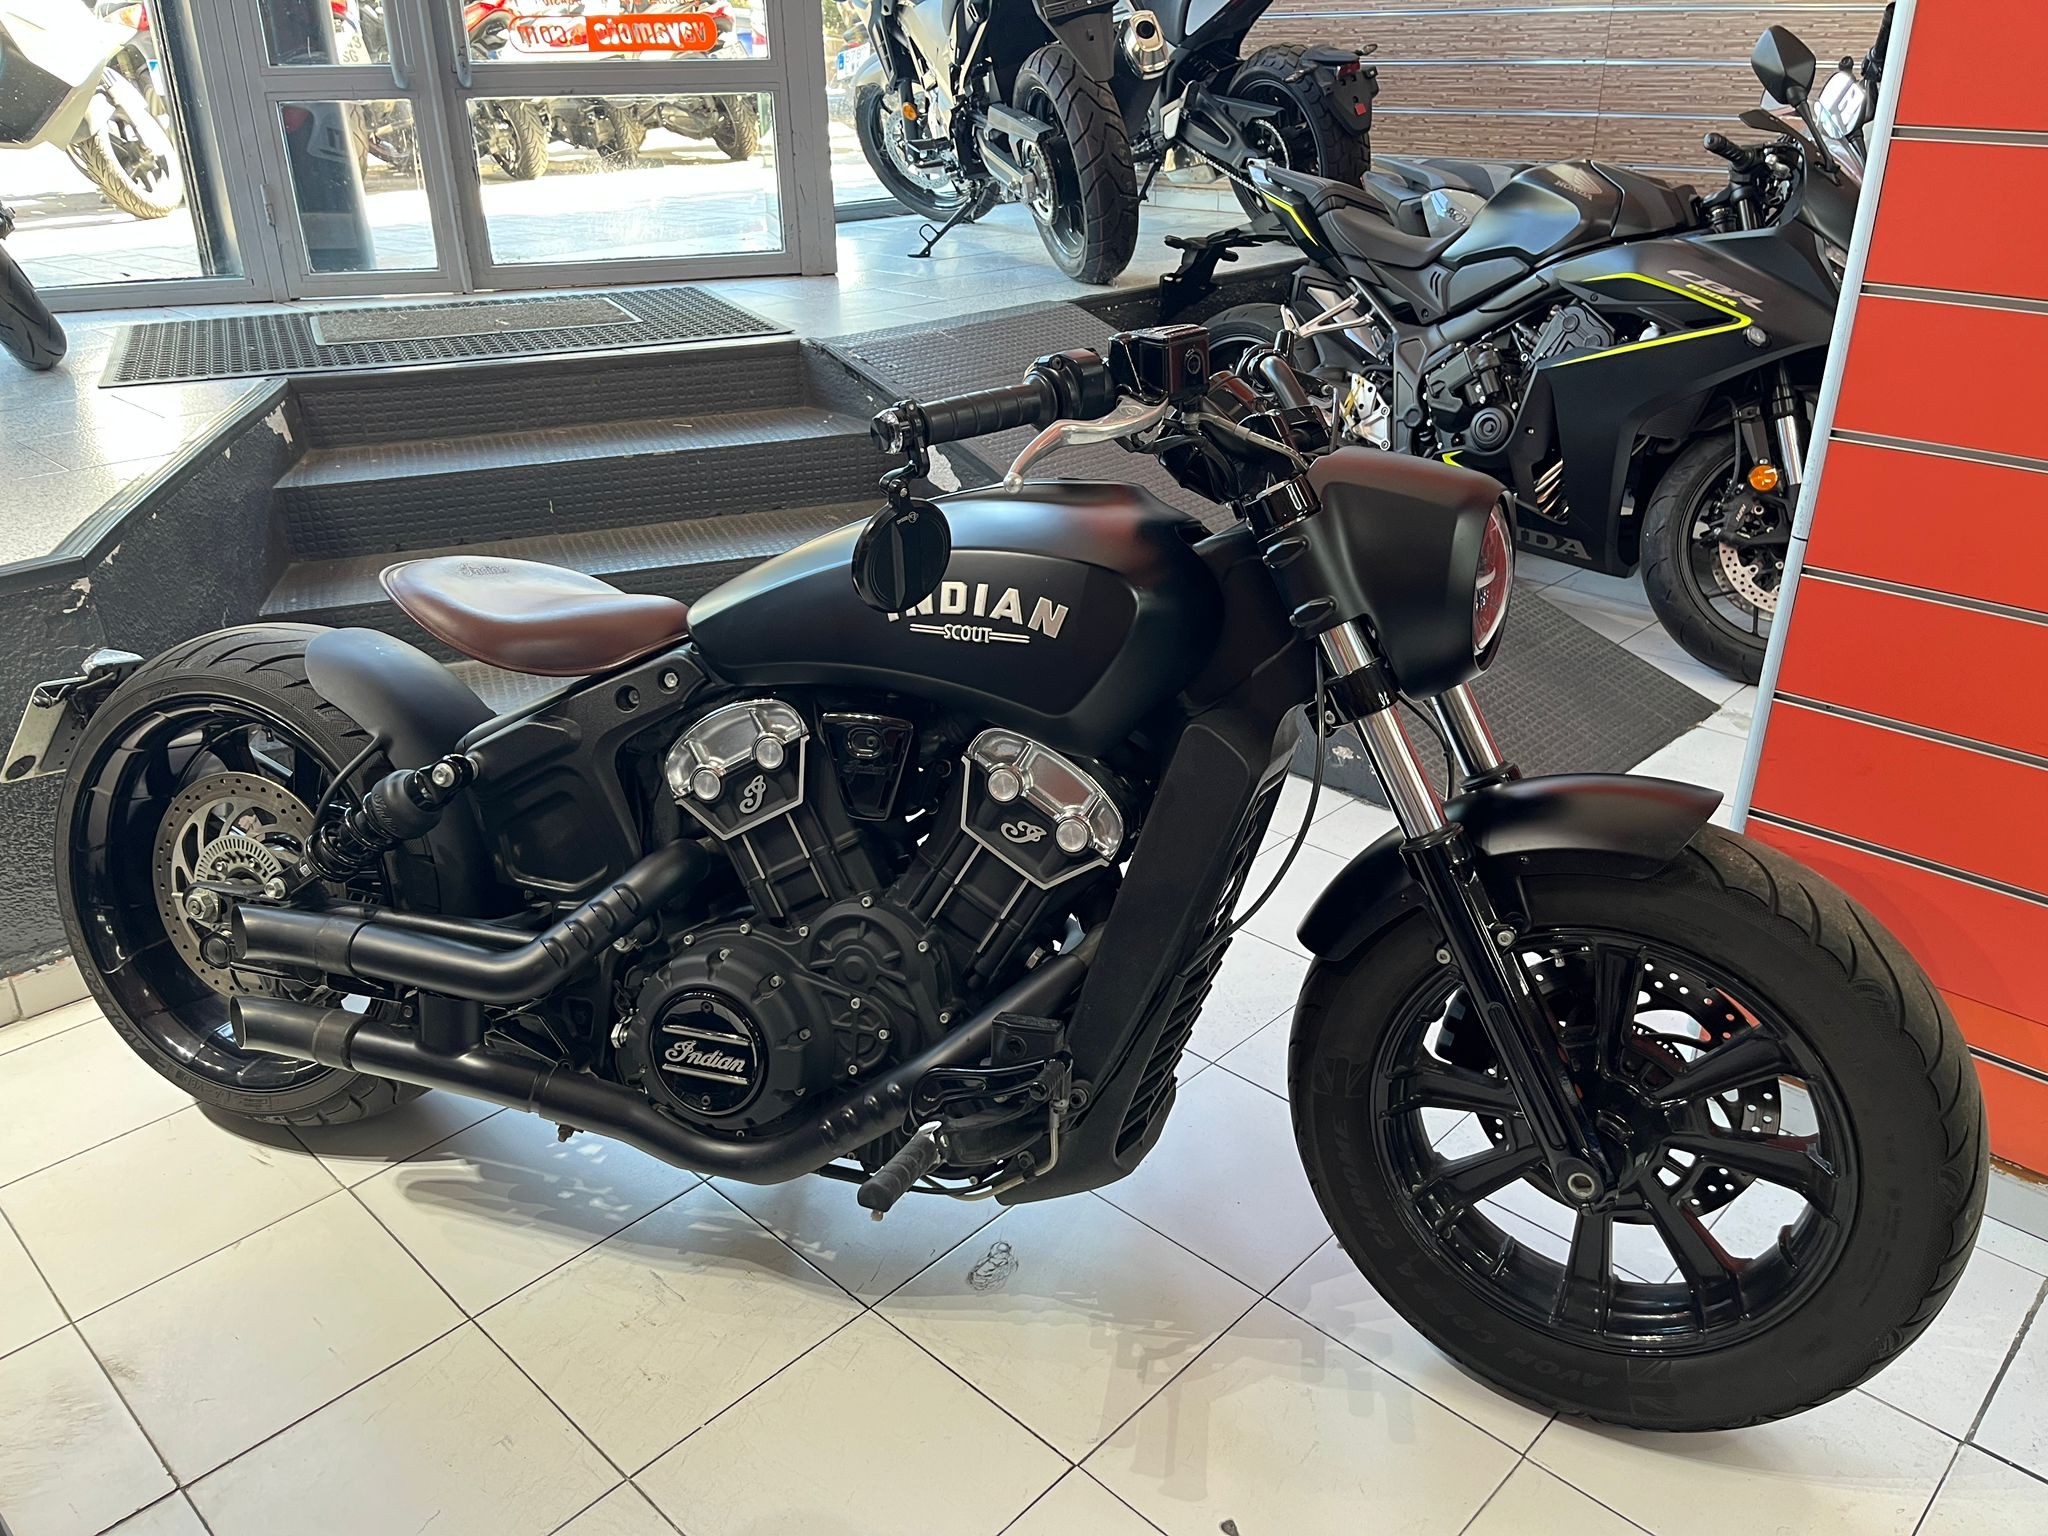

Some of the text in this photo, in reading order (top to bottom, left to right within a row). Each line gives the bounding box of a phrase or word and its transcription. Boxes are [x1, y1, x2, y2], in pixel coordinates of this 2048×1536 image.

[1667, 269, 1764, 312] CBR
[887, 581, 1070, 639] DIAN
[943, 623, 993, 643] SCOUT
[664, 1039, 747, 1073] Indian
[1506, 1346, 1609, 1387] AVON
